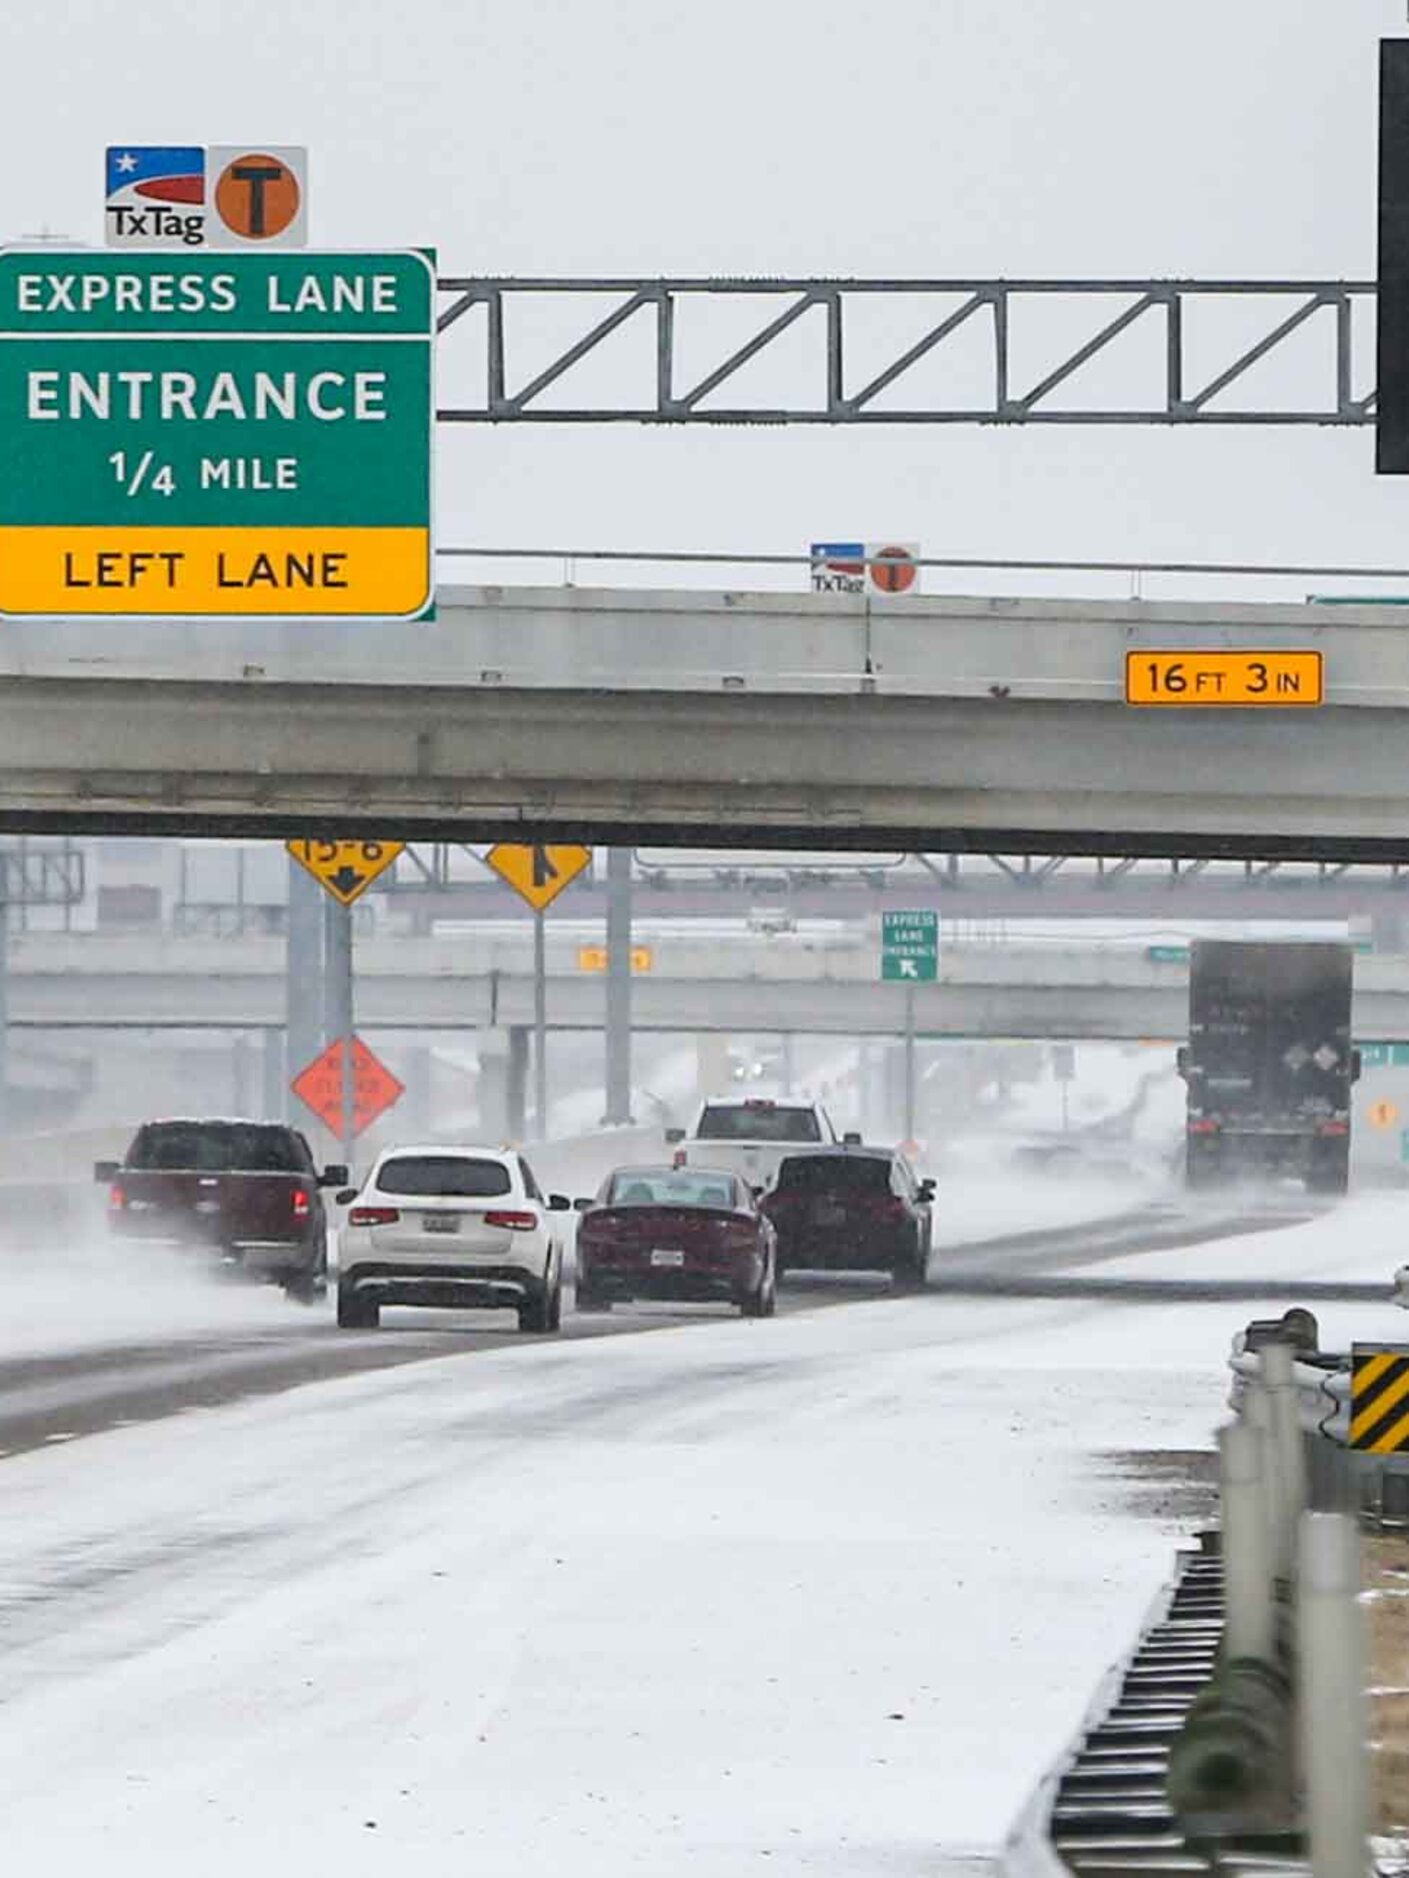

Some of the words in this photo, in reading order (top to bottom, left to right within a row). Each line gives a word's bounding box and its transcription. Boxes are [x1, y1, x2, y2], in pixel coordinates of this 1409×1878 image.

[231, 167, 281, 234] T
[107, 206, 204, 245] TxTag
[18, 274, 237, 312] EXPRESS
[268, 275, 398, 312] LANE
[28, 371, 386, 420] ENTRANCE
[109, 451, 175, 496] 1/4
[201, 458, 298, 489] MILE
[65, 552, 185, 588] LEFT
[217, 553, 348, 588] LANE
[1148, 664, 1187, 692] 16
[1196, 673, 1226, 692] FT
[1246, 664, 1268, 693] 3
[1278, 674, 1299, 692] IN
